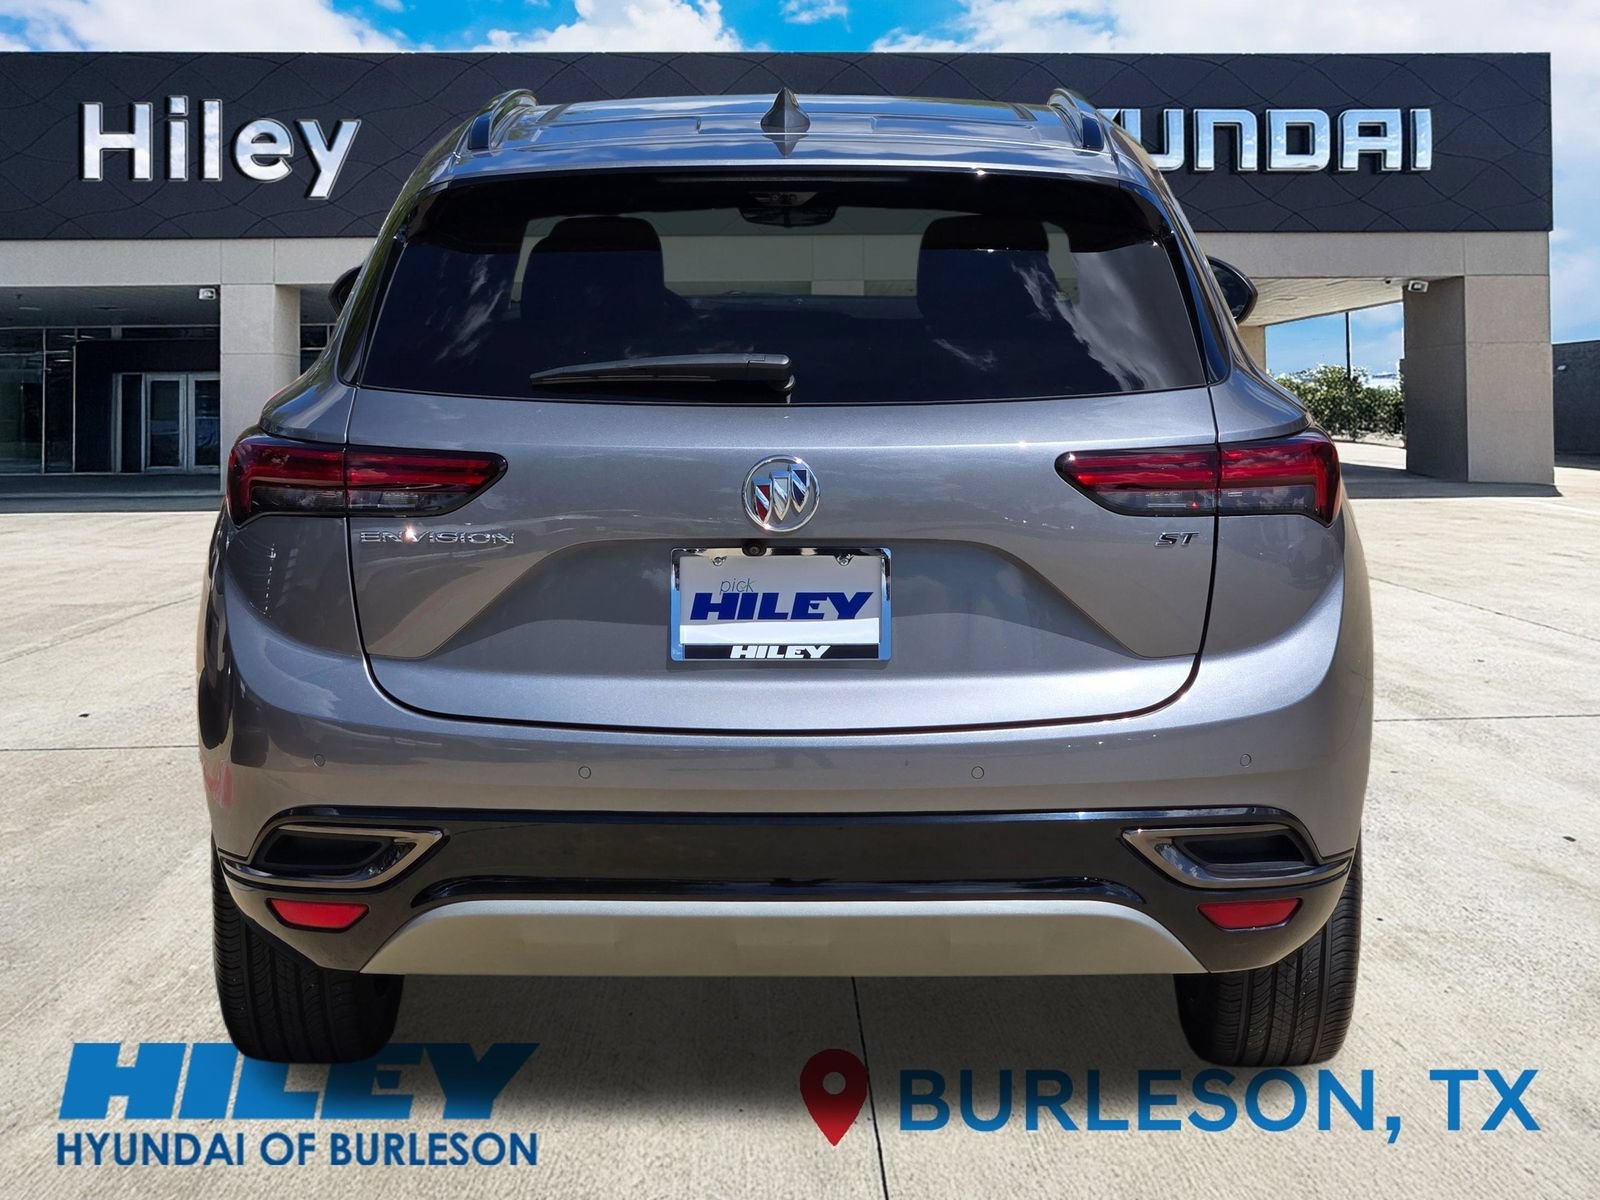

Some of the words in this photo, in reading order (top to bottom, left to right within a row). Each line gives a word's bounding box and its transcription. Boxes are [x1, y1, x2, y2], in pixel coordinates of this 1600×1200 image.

[80, 95, 362, 199] Hiley
[1098, 107, 1432, 172] UNDAI
[360, 531, 516, 545] ENVISION
[1154, 532, 1200, 546] ST
[719, 577, 755, 594] pick
[690, 592, 874, 620] HILEY
[729, 645, 831, 659] HILEY
